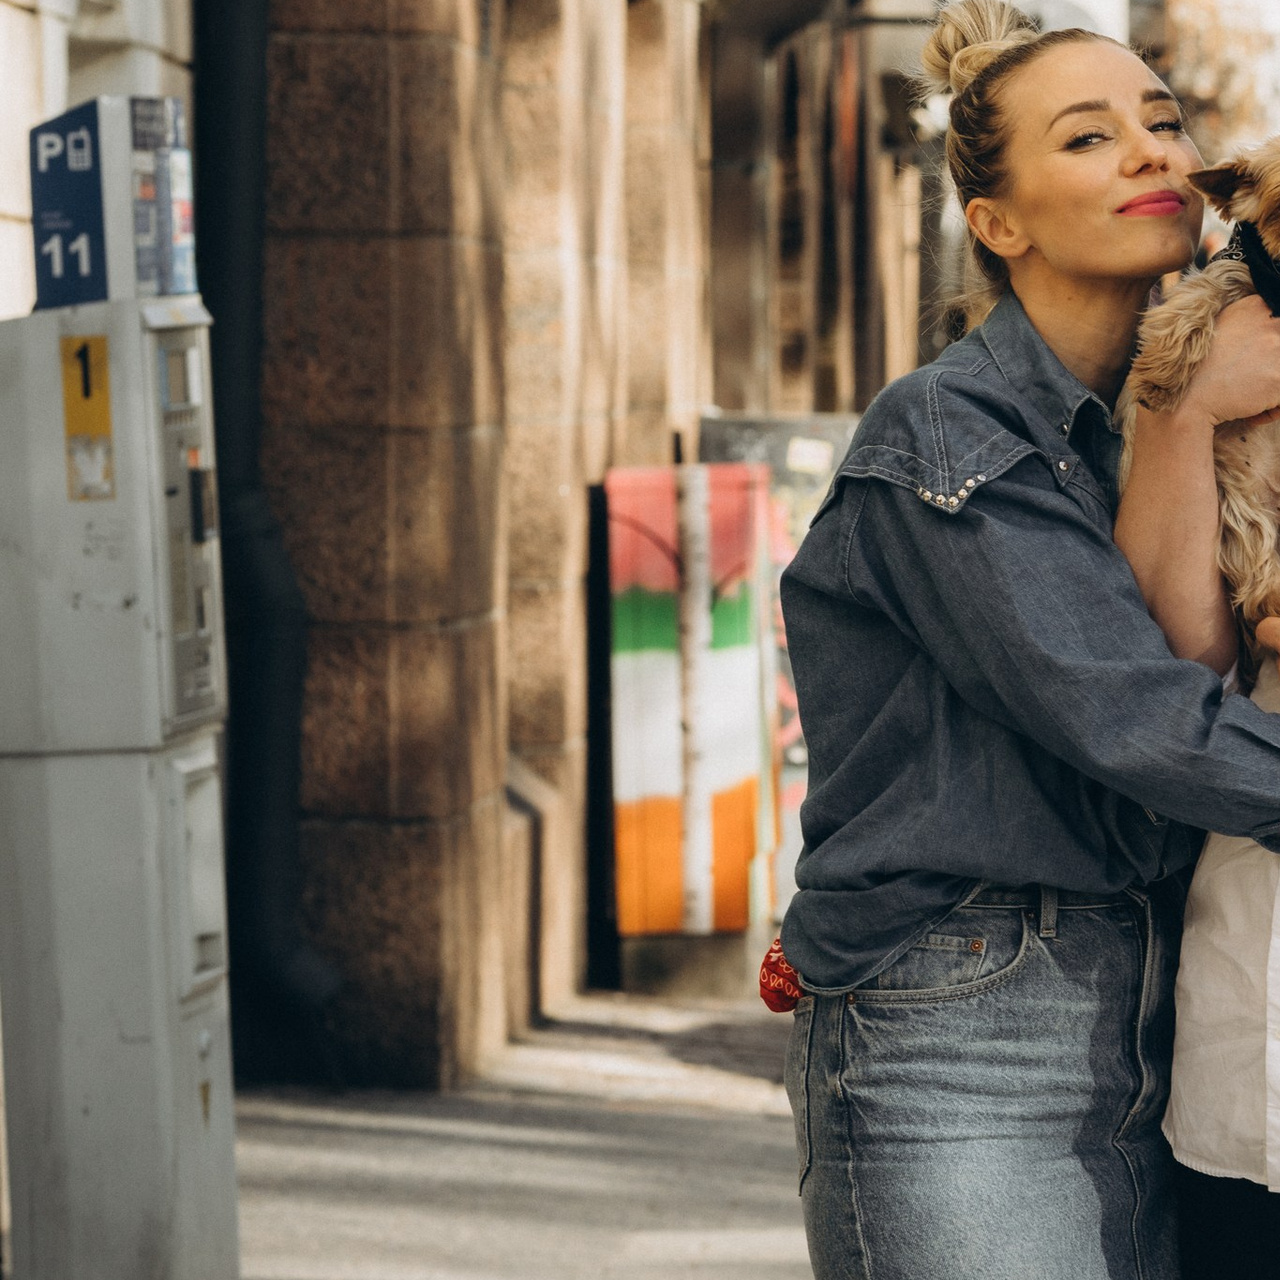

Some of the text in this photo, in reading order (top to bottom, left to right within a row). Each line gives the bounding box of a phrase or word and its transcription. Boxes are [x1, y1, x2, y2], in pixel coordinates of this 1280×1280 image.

[37, 132, 64, 173] P
[41, 232, 91, 278] 11
[75, 342, 92, 399] 1
